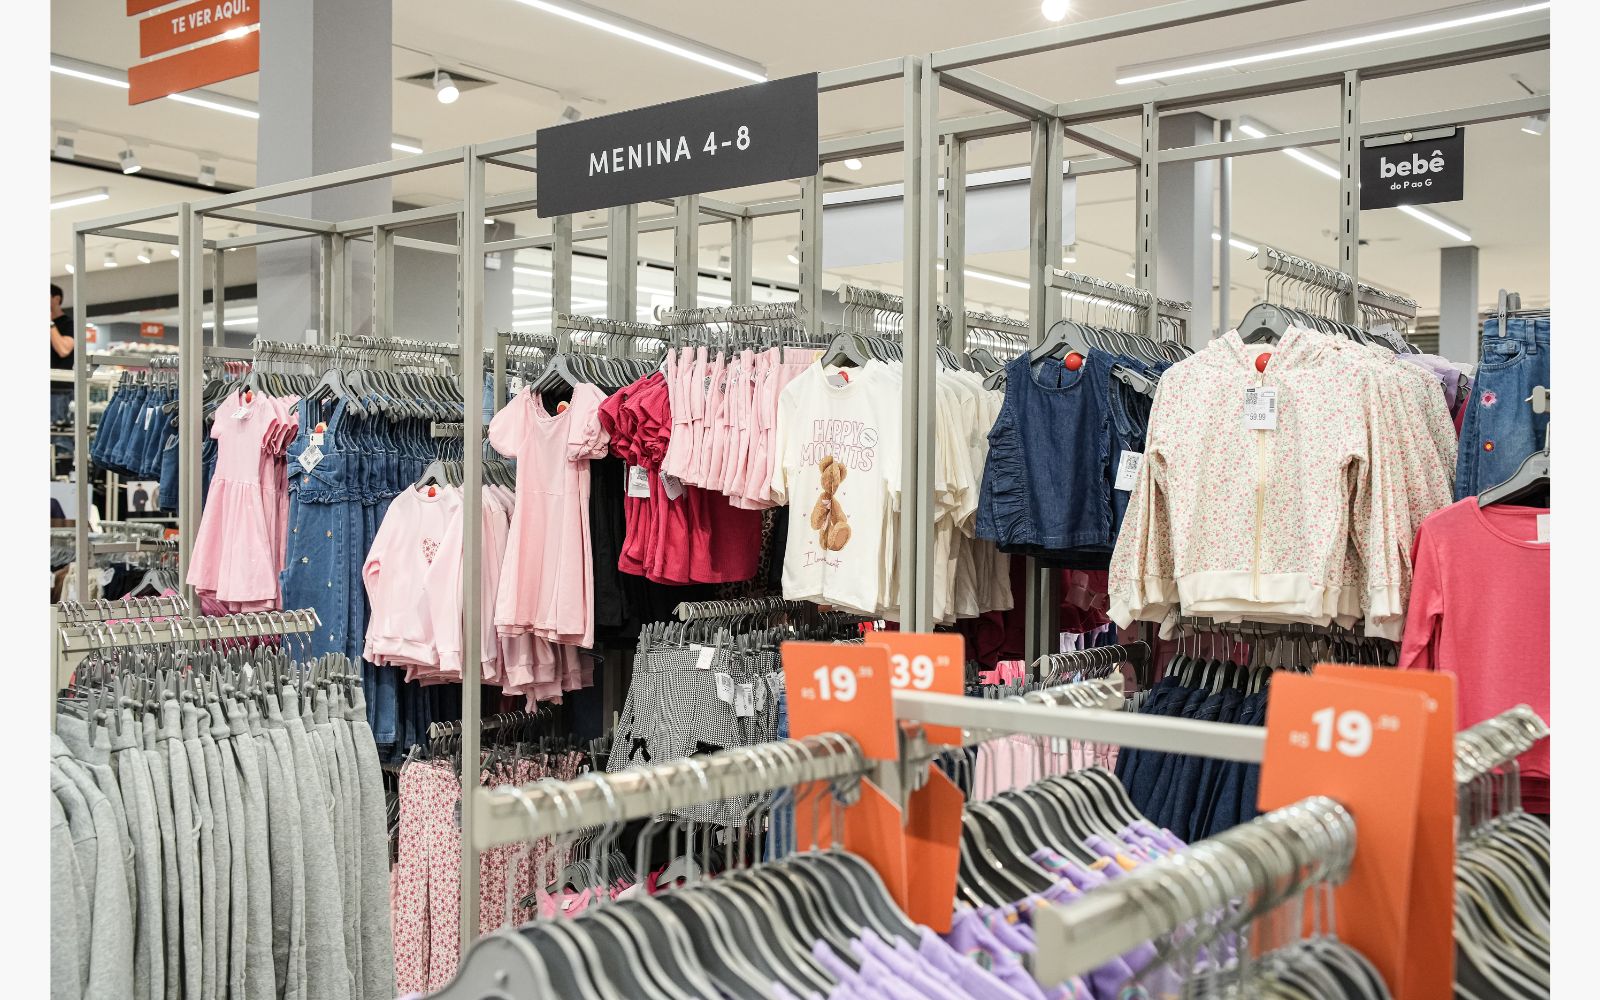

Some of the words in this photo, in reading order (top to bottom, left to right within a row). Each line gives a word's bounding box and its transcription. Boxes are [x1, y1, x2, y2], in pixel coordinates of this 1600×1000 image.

[171, 16, 186, 34] TE
[188, 8, 212, 29] VER
[588, 135, 692, 177] MENINA
[702, 125, 751, 156] 4-8
[1380, 149, 1445, 179] bebê
[1390, 182, 1402, 190] do
[1403, 181, 1410, 189] P
[1424, 178, 1433, 187] G
[813, 419, 865, 446] HAPPY
[813, 665, 858, 702] 19
[890, 653, 935, 690] 39
[1311, 706, 1374, 758] 19
